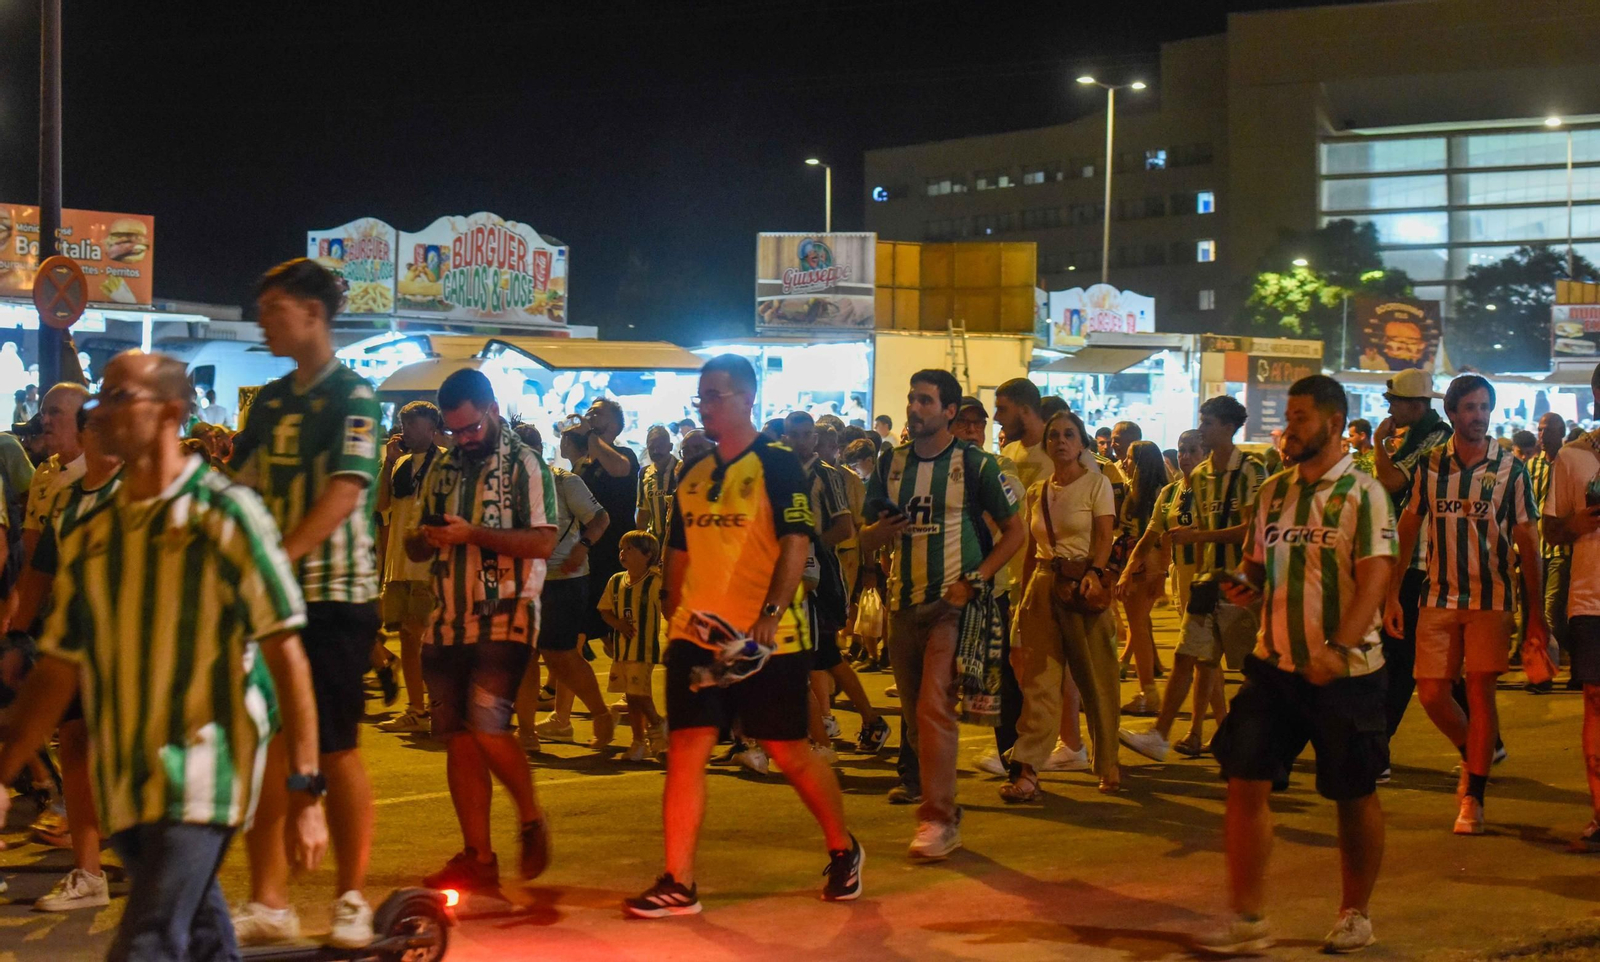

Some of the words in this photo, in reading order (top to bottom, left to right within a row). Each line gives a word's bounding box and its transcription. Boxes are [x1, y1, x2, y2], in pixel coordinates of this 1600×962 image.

[15, 235, 103, 260] Botalia
[452, 226, 528, 273] BURGUER
[443, 265, 488, 311] CARLOS
[492, 269, 502, 312] &
[506, 273, 535, 308] JOSE
[782, 265, 852, 293] Giuseppe
[697, 513, 747, 527] GREE
[1281, 525, 1340, 546] GREE
